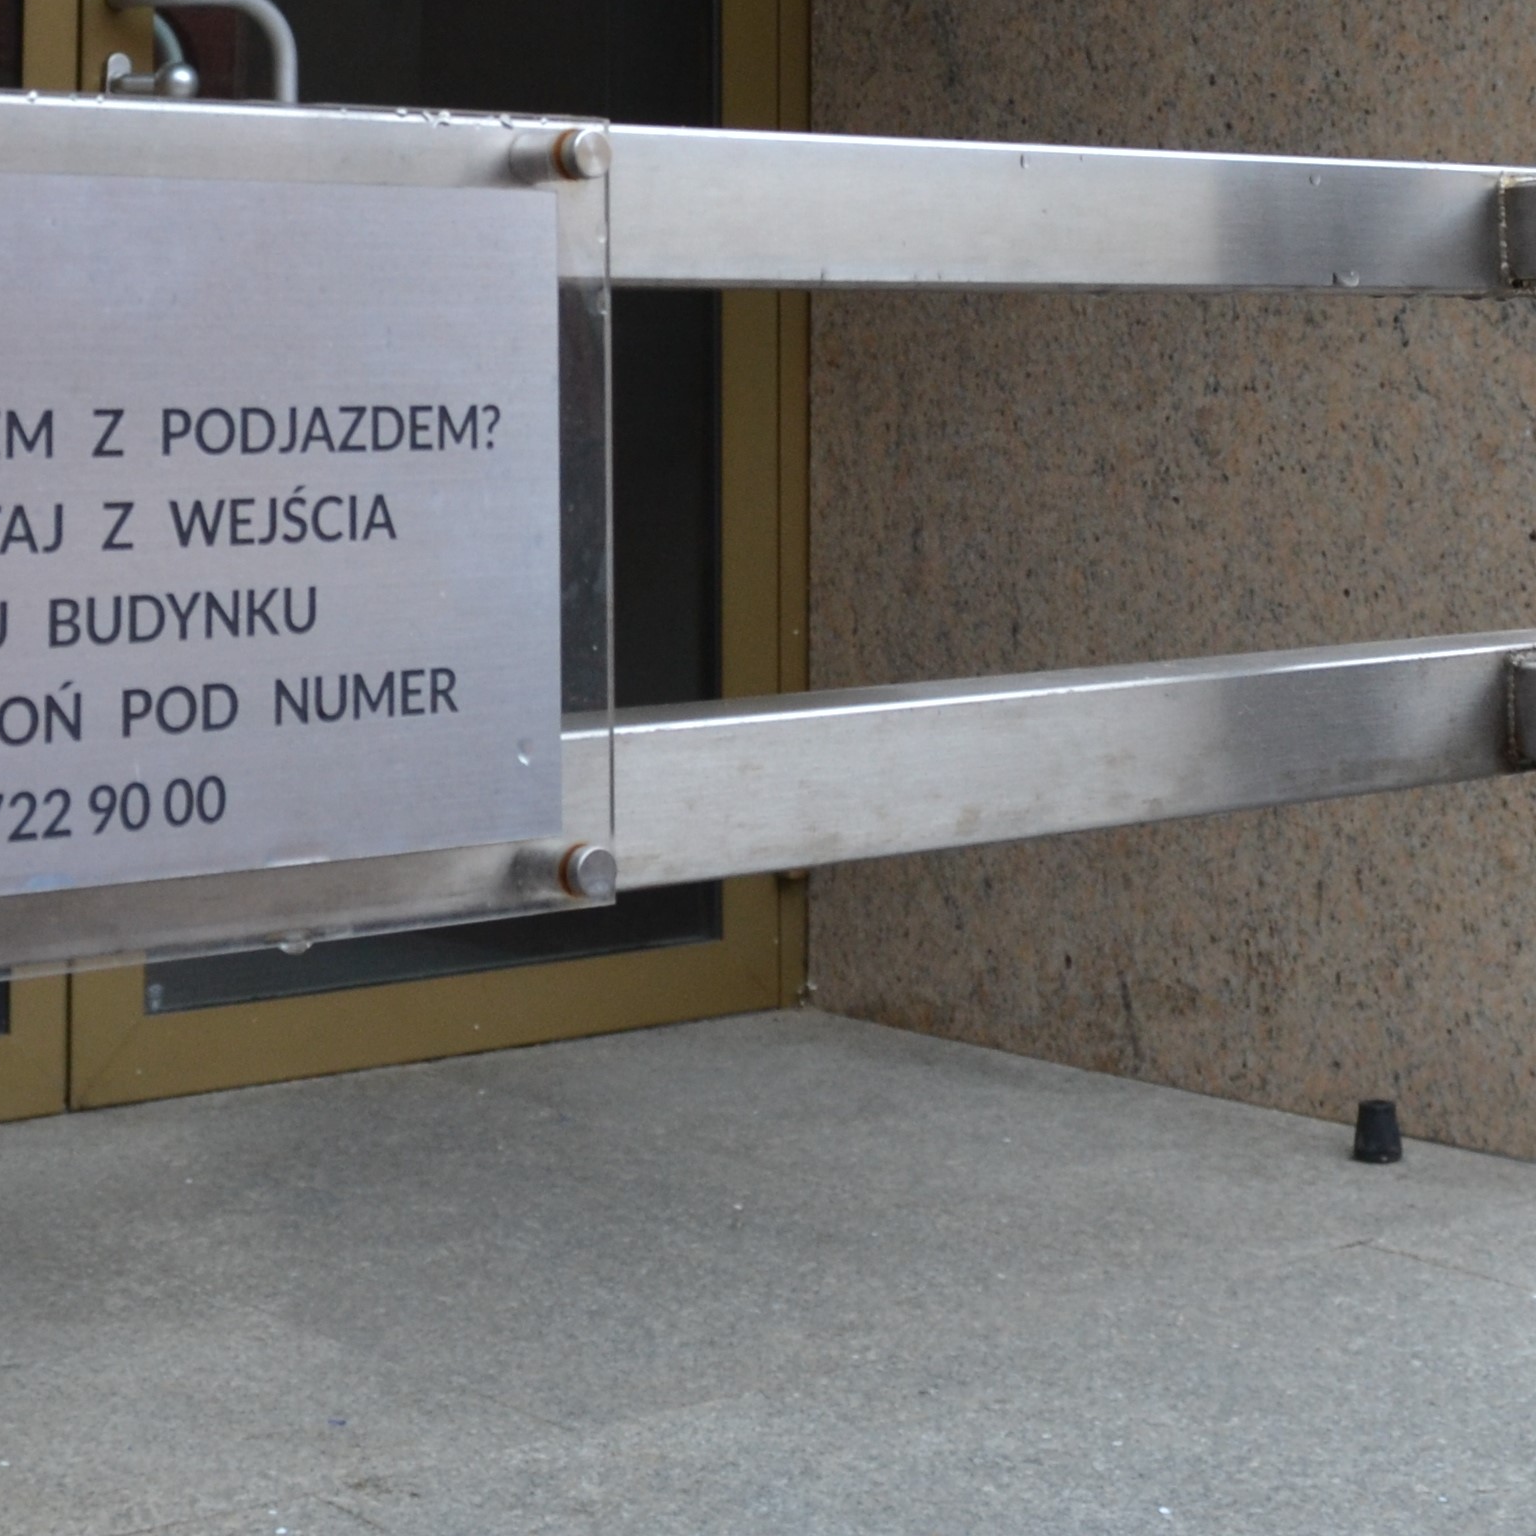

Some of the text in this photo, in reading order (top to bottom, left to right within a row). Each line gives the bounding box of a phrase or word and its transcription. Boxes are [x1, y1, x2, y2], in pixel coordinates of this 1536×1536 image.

[91, 408, 125, 458] Z
[161, 404, 502, 457] PODJAZDEM?
[101, 501, 135, 551] Z
[169, 485, 398, 548] WEJŚCIA
[48, 585, 318, 649] BUDYNKU
[121, 682, 240, 739] POD
[274, 666, 459, 726] NUMER
[88, 781, 151, 836] 90
[163, 775, 227, 828] 00
